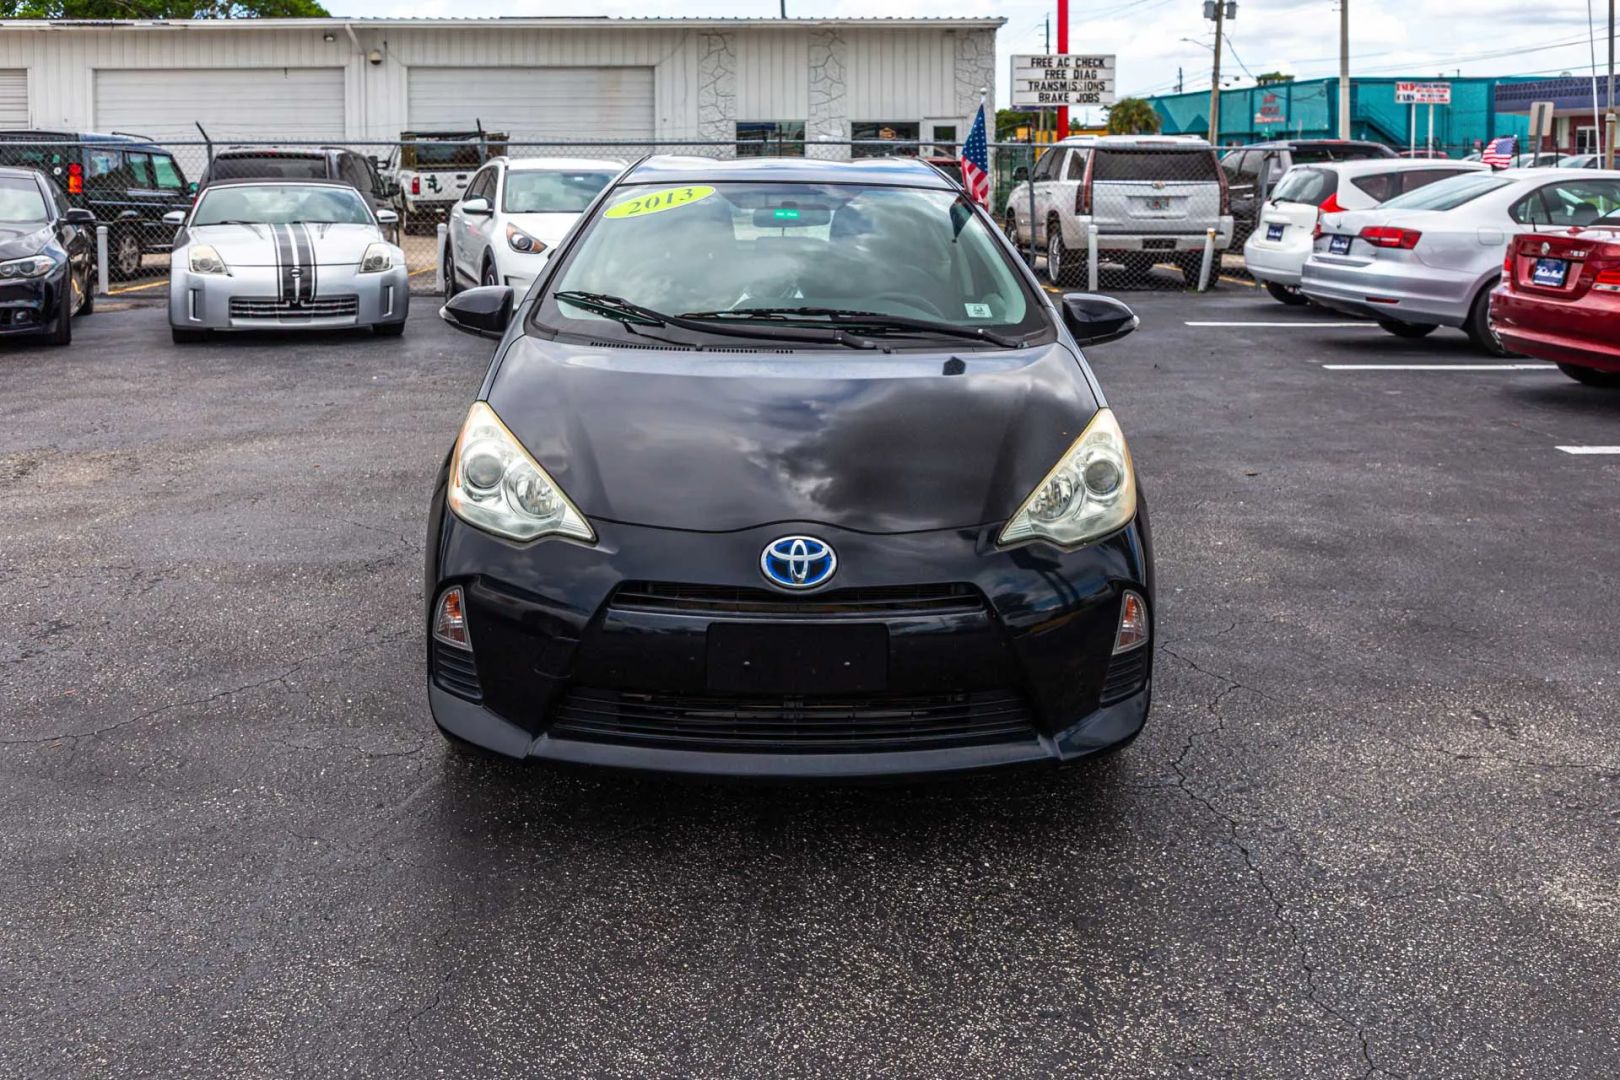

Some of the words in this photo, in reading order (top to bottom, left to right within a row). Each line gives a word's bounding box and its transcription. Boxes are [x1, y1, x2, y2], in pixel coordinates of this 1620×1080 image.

[1031, 57, 1053, 67] FREE
[1057, 57, 1070, 67] AC
[1075, 57, 1105, 68] CHECK
[1044, 69, 1067, 79] FREE
[1073, 69, 1097, 80] DIAG
[1028, 81, 1105, 92] TRANSMISSIONS
[1038, 92, 1069, 103] BRAKE
[1076, 92, 1100, 103] JOBS
[628, 188, 693, 215] 2013
